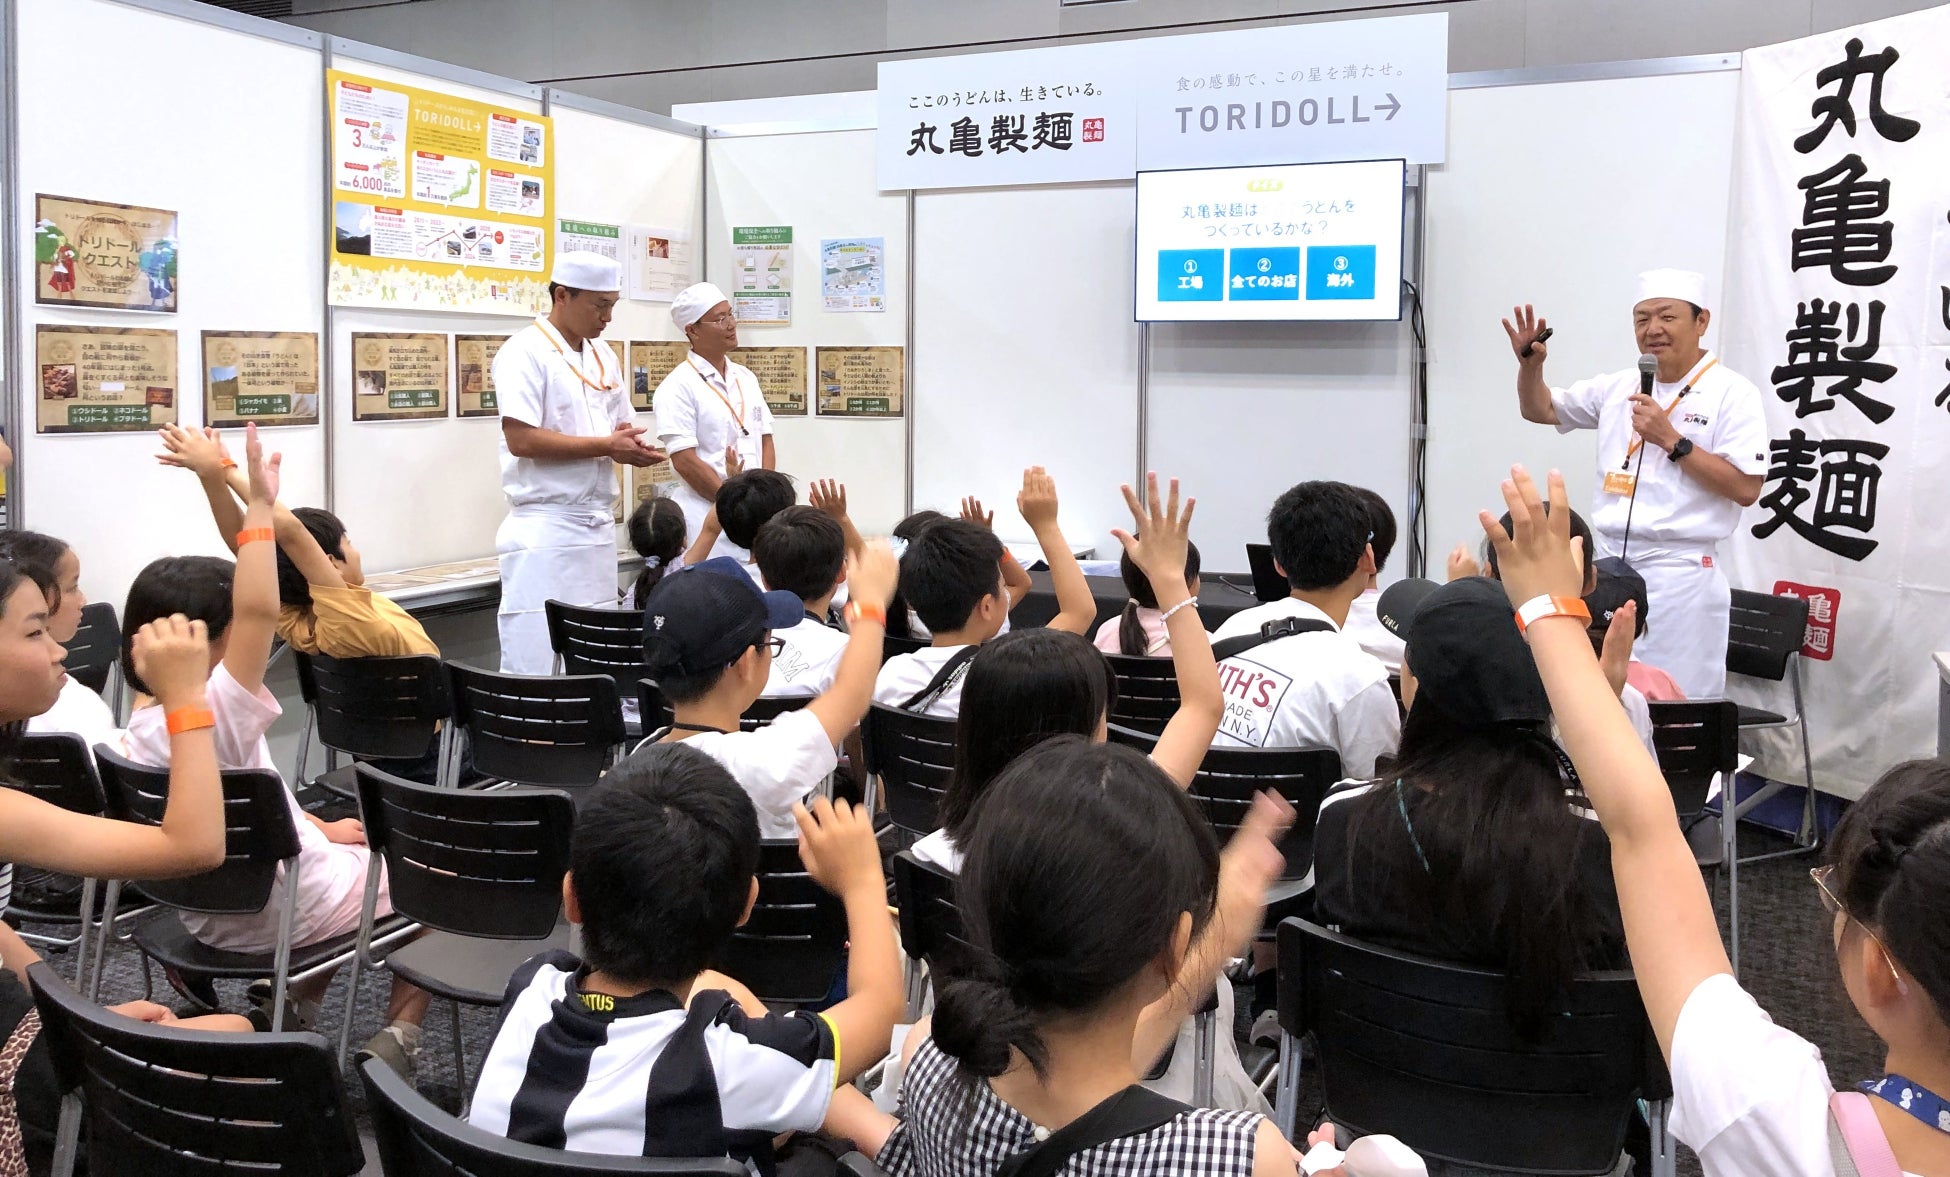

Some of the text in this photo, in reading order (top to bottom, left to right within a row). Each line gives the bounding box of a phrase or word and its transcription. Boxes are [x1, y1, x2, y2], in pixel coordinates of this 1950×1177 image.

[1176, 62, 1403, 92] 食の感動で、この星を満たせ。
[909, 82, 1102, 108] ここのうどんは、生きている。
[414, 109, 473, 131] TORIDOLL
[1175, 95, 1370, 133] TORIDOLL
[907, 111, 1074, 157] 丸亀製麺
[352, 175, 382, 191] 6,000
[1181, 203, 1258, 219] 丸亀製麺は
[83, 252, 137, 269] クエスト
[1178, 276, 1203, 289] 工場
[1231, 274, 1297, 288] 全てのお店
[1326, 272, 1354, 287] 海外
[1751, 37, 1921, 562] 丸亀製麺
[1216, 662, 1276, 708] ITH'S
[1225, 702, 1253, 721] ADE
[576, 992, 614, 1011] NTUS
